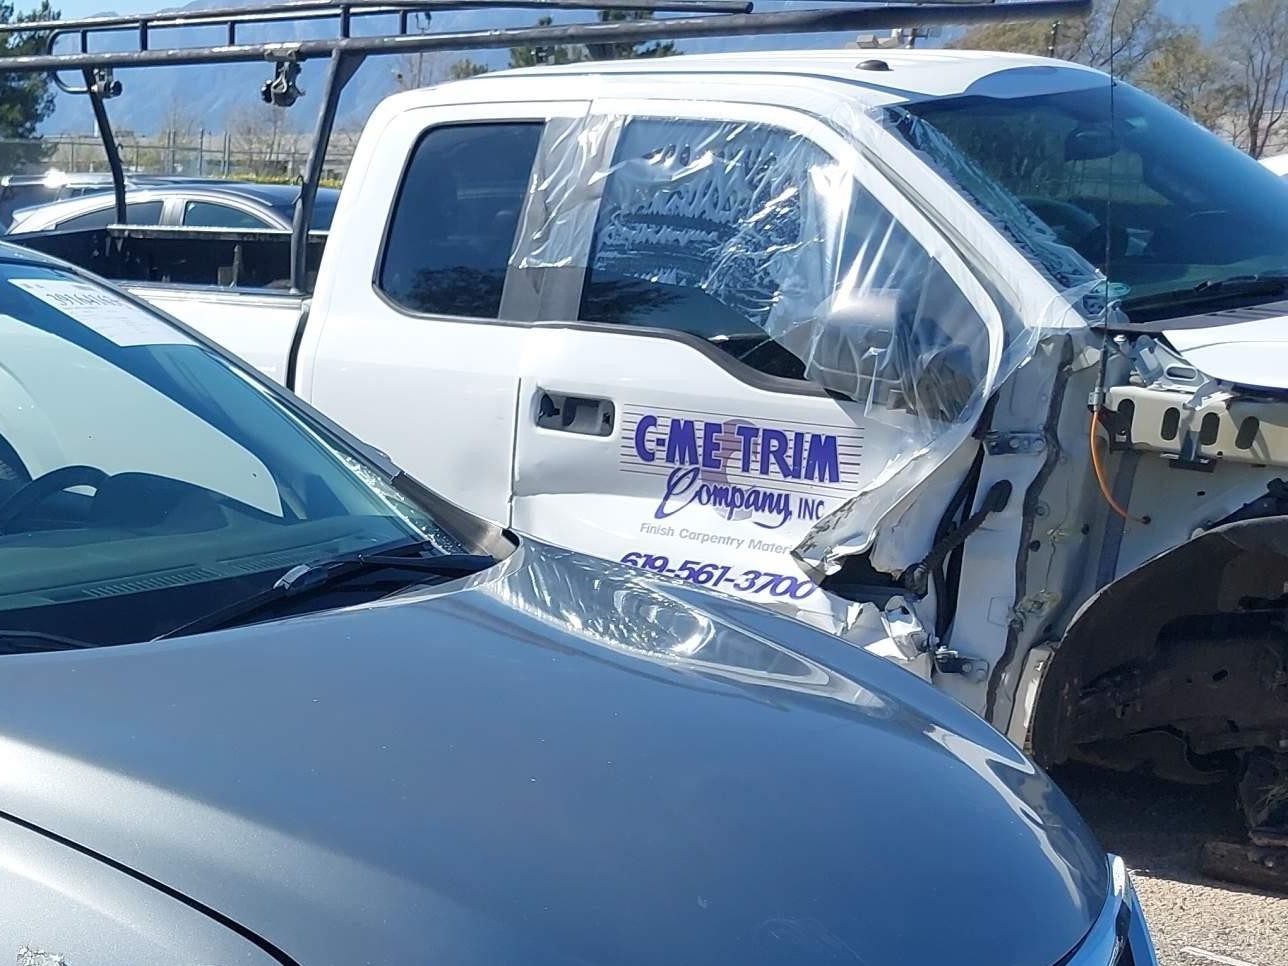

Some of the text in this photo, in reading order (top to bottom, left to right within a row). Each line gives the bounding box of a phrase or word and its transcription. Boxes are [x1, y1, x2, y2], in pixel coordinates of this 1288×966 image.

[634, 414, 840, 483] C-ME TRIM
[639, 522, 675, 537] Finish
[679, 528, 745, 550] Carpentry
[620, 551, 818, 600] 619-561-3700
